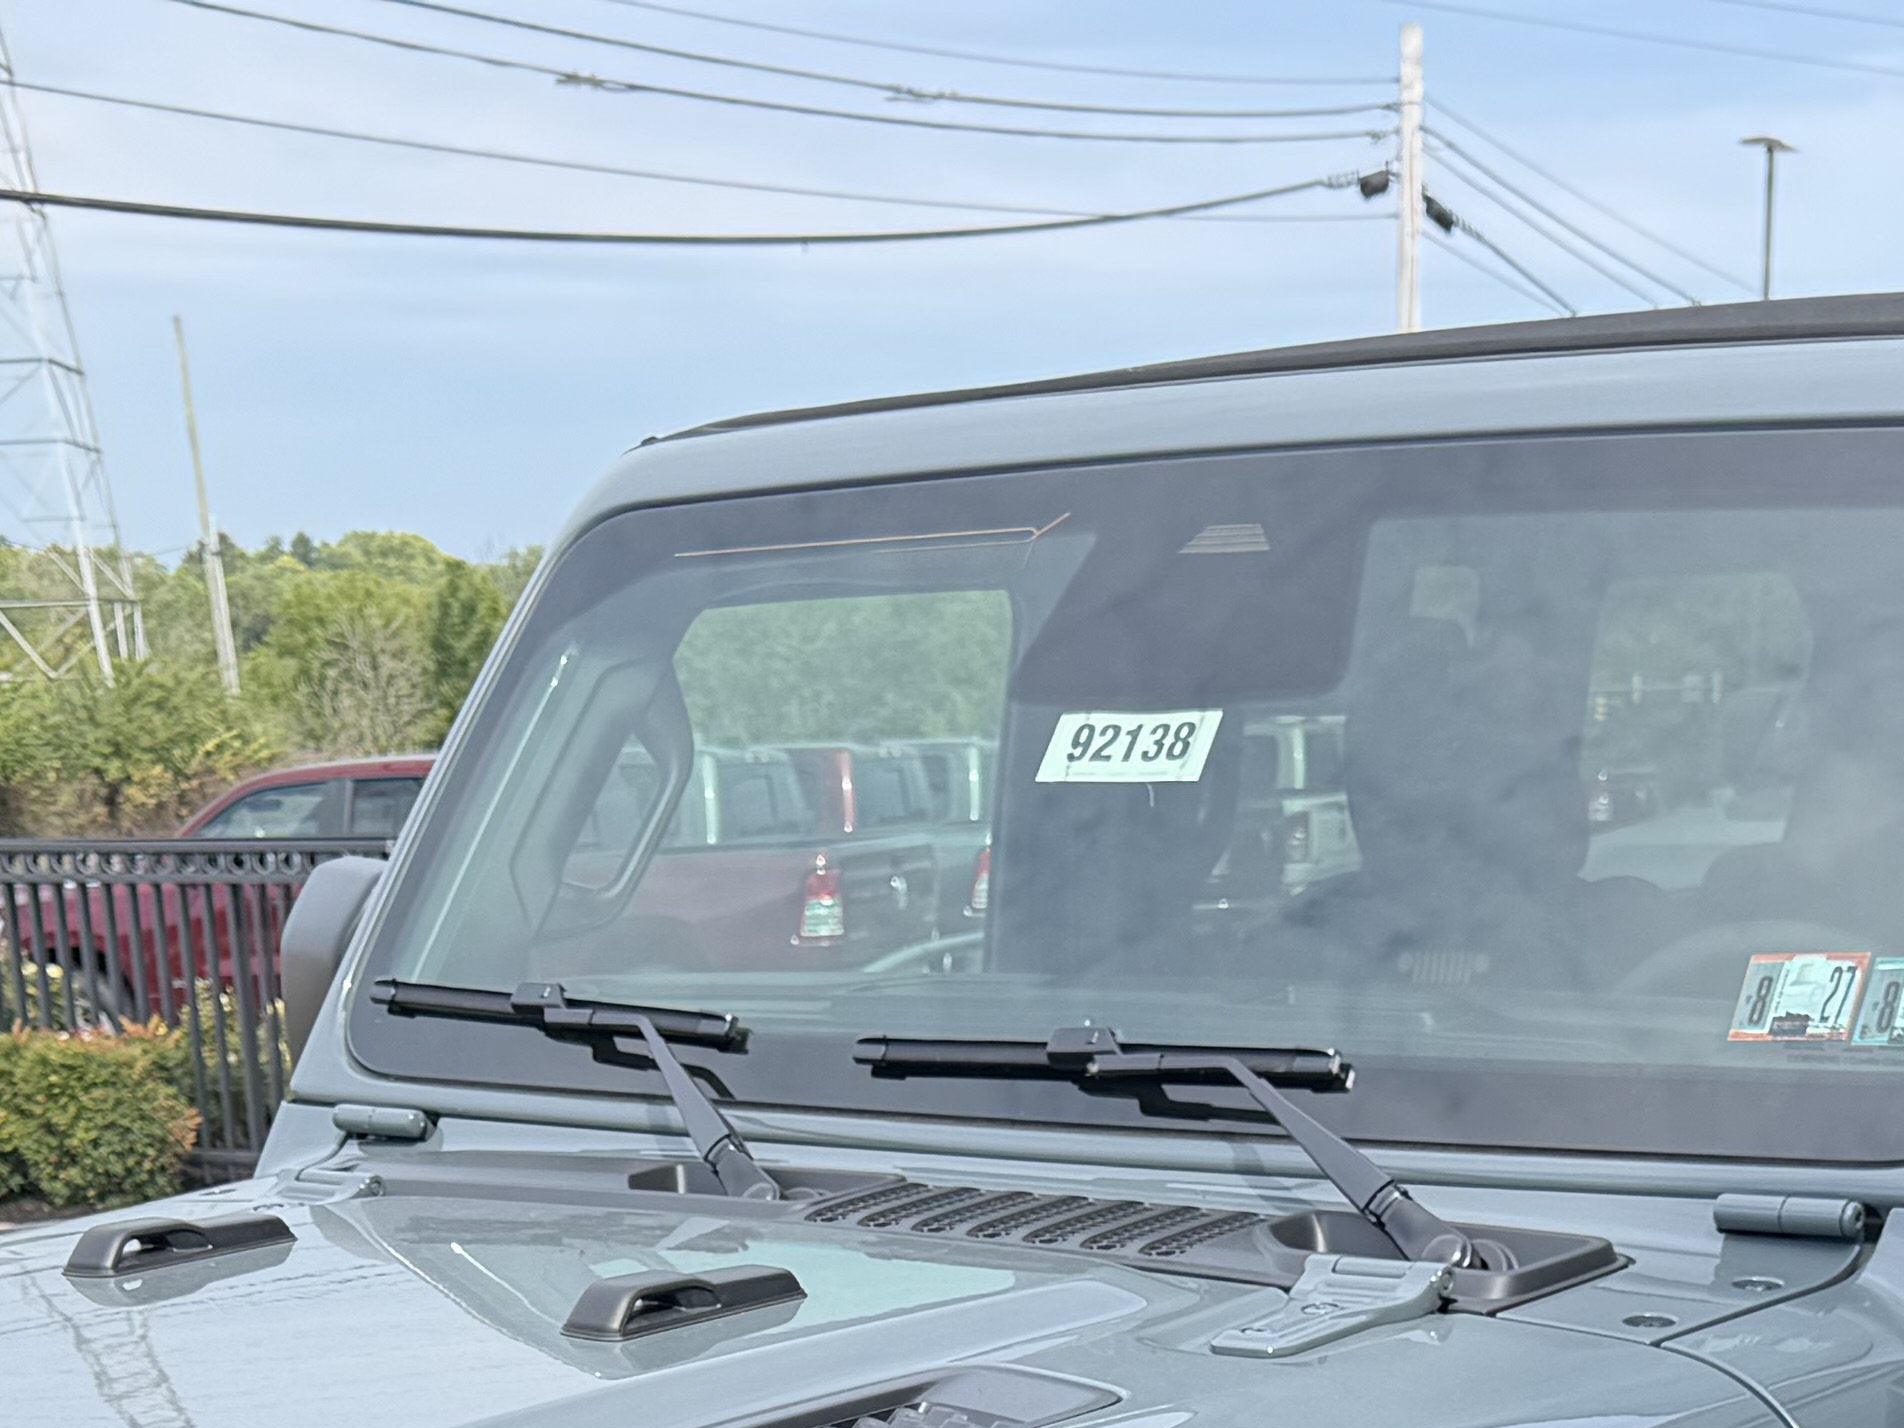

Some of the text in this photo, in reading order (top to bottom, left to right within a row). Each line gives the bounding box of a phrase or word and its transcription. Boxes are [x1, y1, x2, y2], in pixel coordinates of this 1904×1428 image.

[1066, 721, 1197, 763] 92138
[1747, 974, 1774, 1026] 8
[1818, 965, 1859, 1024] 27
[1875, 980, 1901, 1034] 8
